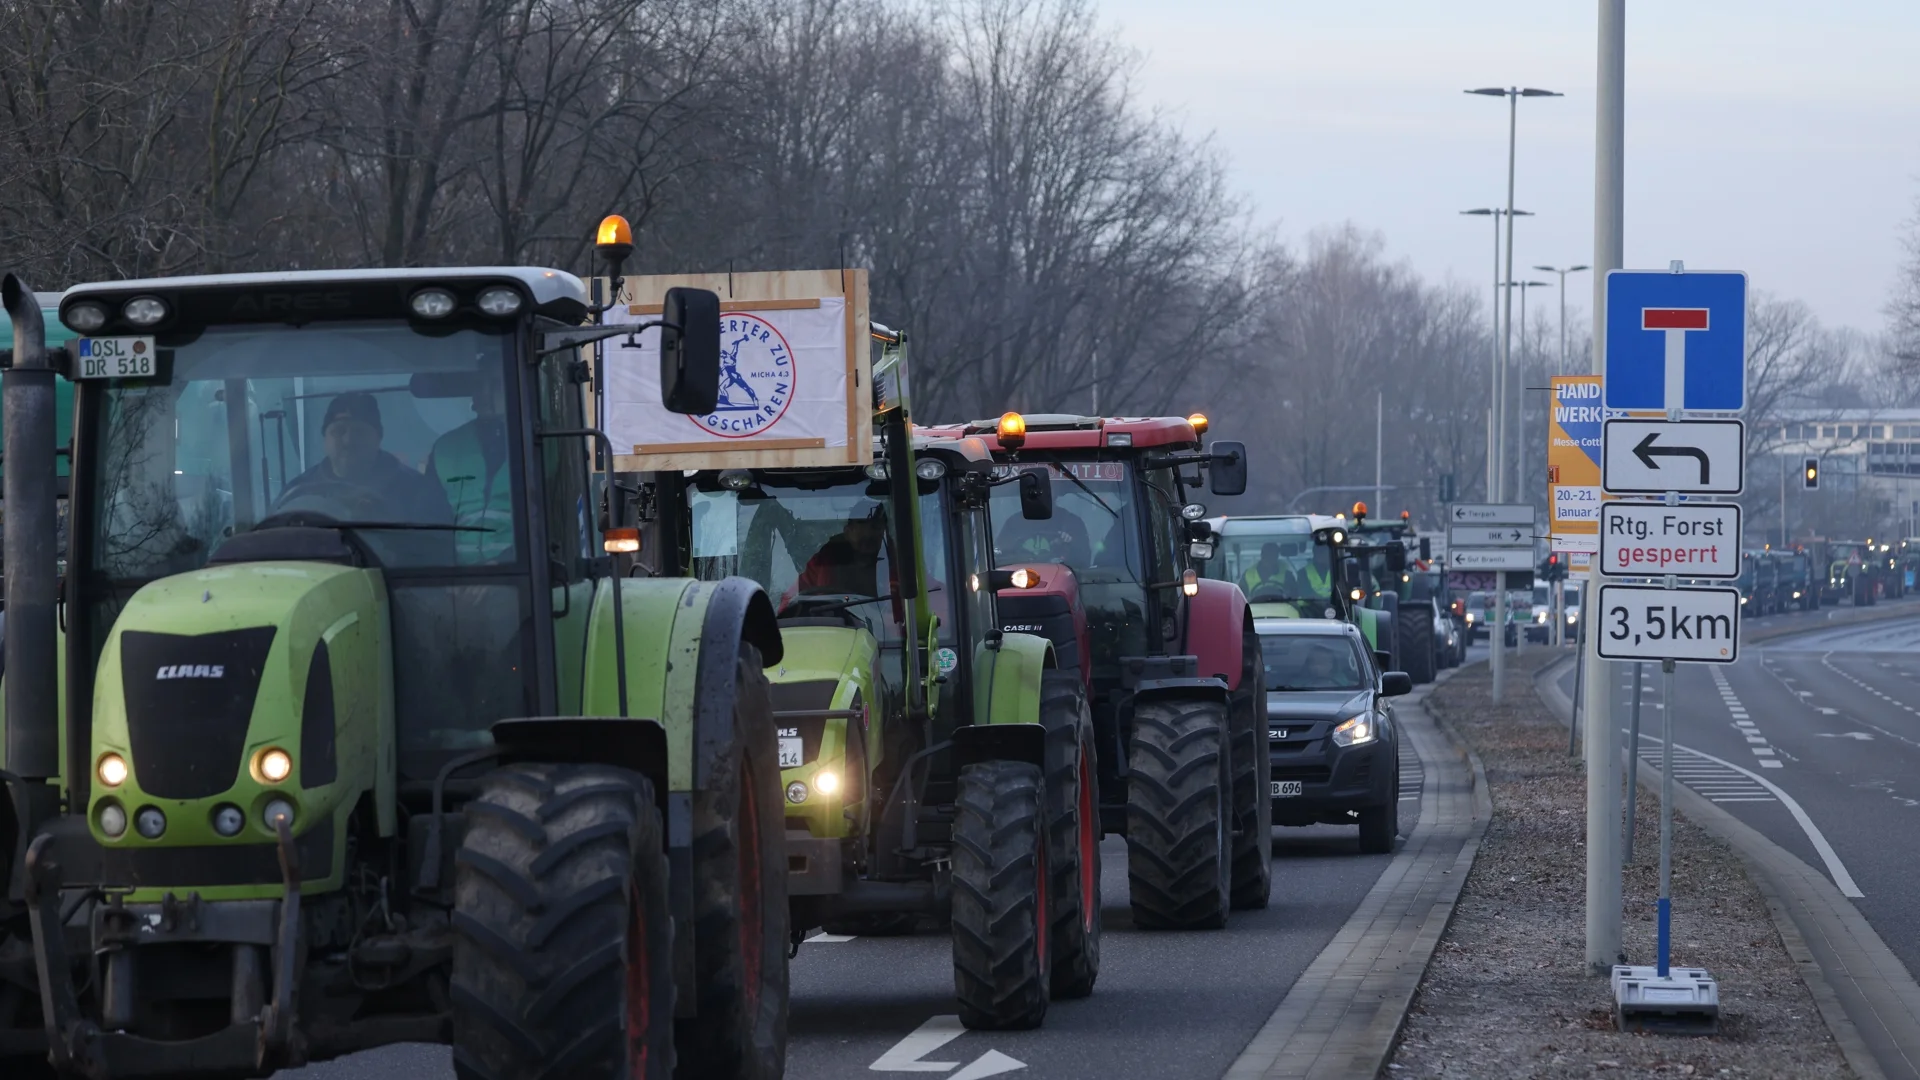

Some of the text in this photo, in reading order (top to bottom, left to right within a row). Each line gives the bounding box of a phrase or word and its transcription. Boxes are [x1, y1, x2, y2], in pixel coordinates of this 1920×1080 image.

[92, 340, 125, 357] OSL
[720, 320, 788, 366] ERTER ZU
[85, 357, 150, 376] DR 518
[1556, 383, 1601, 399] HAND
[697, 382, 788, 431] GSCHAREN
[1553, 437, 1602, 447] Messe Cott
[1557, 507, 1592, 518] Januar
[1488, 531, 1503, 540] IHK
[1610, 515, 1723, 540] Rtg. Forst
[1618, 545, 1718, 567] gesperrt
[1003, 624, 1032, 632] CASE
[1609, 606, 1731, 646] 3,5km
[156, 664, 225, 680] CLAAS
[777, 727, 798, 737] AS
[1268, 730, 1287, 739] ZU
[1281, 782, 1301, 794] 696
